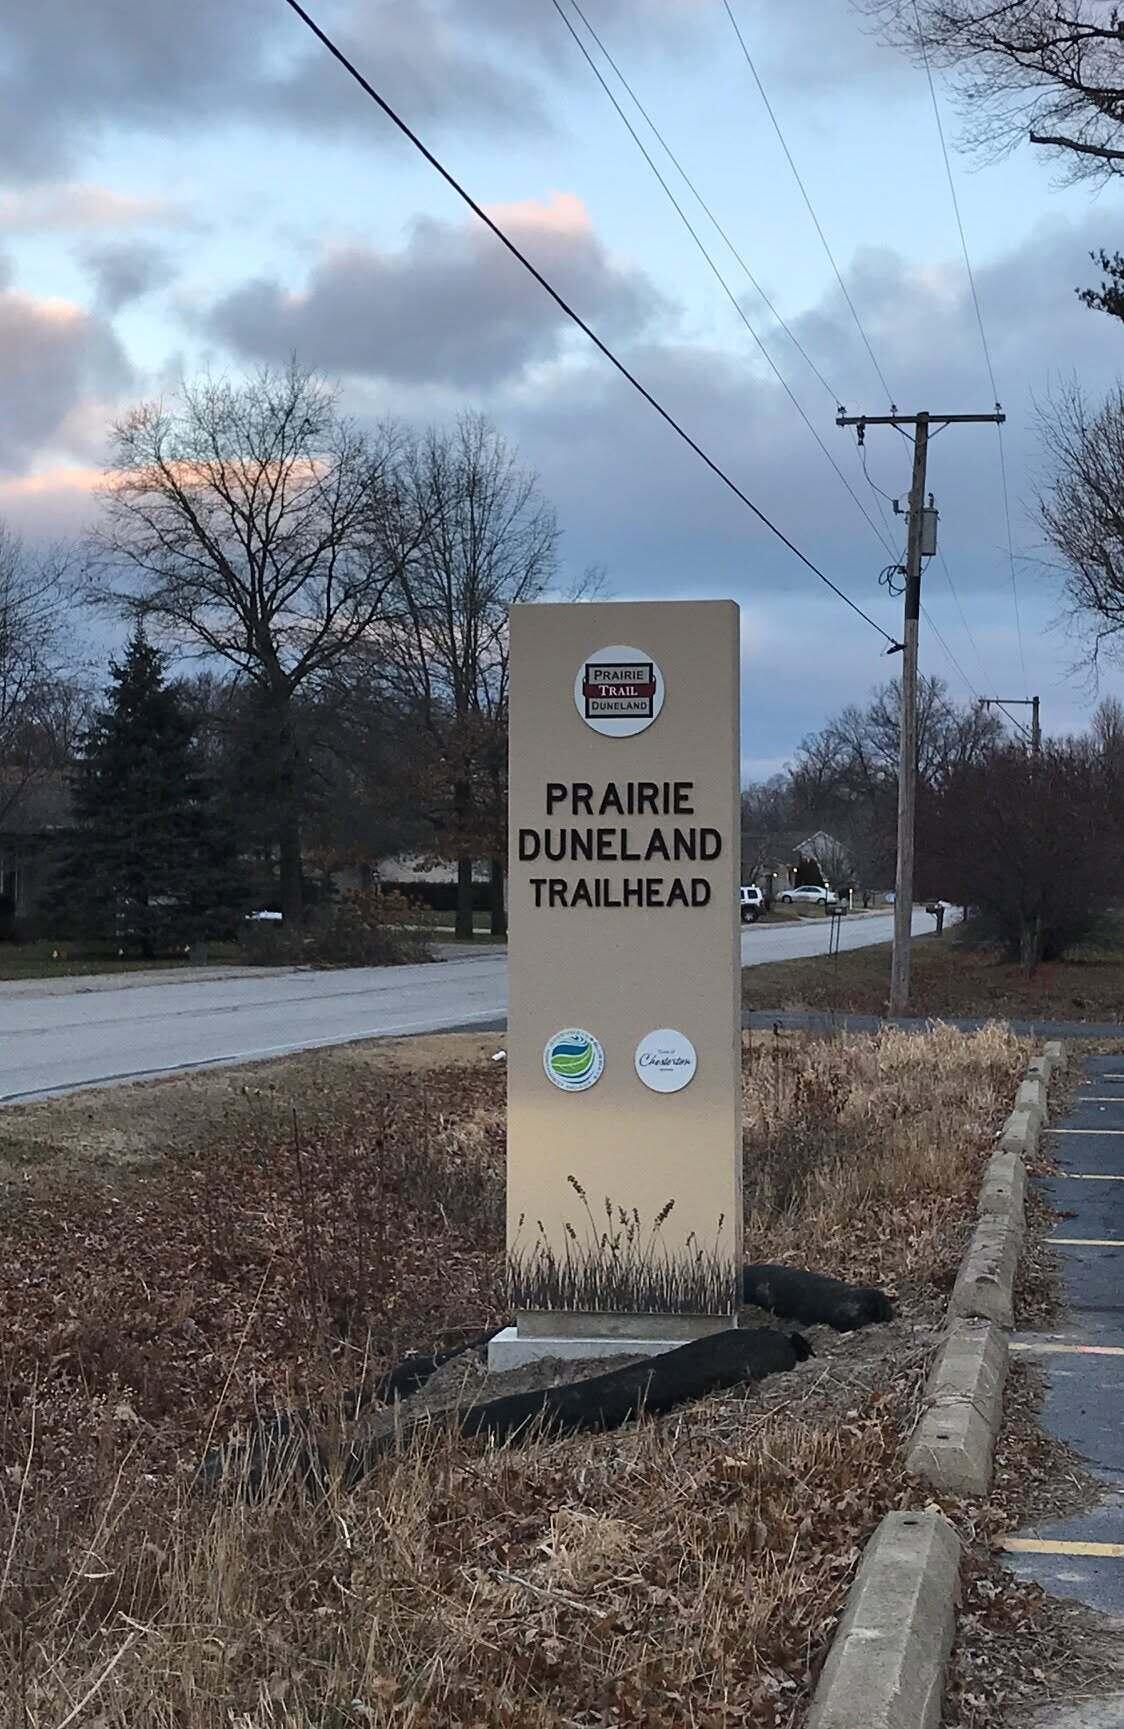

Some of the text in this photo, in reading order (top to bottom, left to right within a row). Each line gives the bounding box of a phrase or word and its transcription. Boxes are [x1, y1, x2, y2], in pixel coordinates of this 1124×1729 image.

[594, 670, 644, 681] PRAIRIE
[598, 685, 638, 696] TRAIL
[592, 701, 647, 711] DUNELAND
[546, 782, 694, 815] PRAIRIE
[518, 828, 722, 861] DUNELAND
[530, 878, 711, 907] TRAILHEAD
